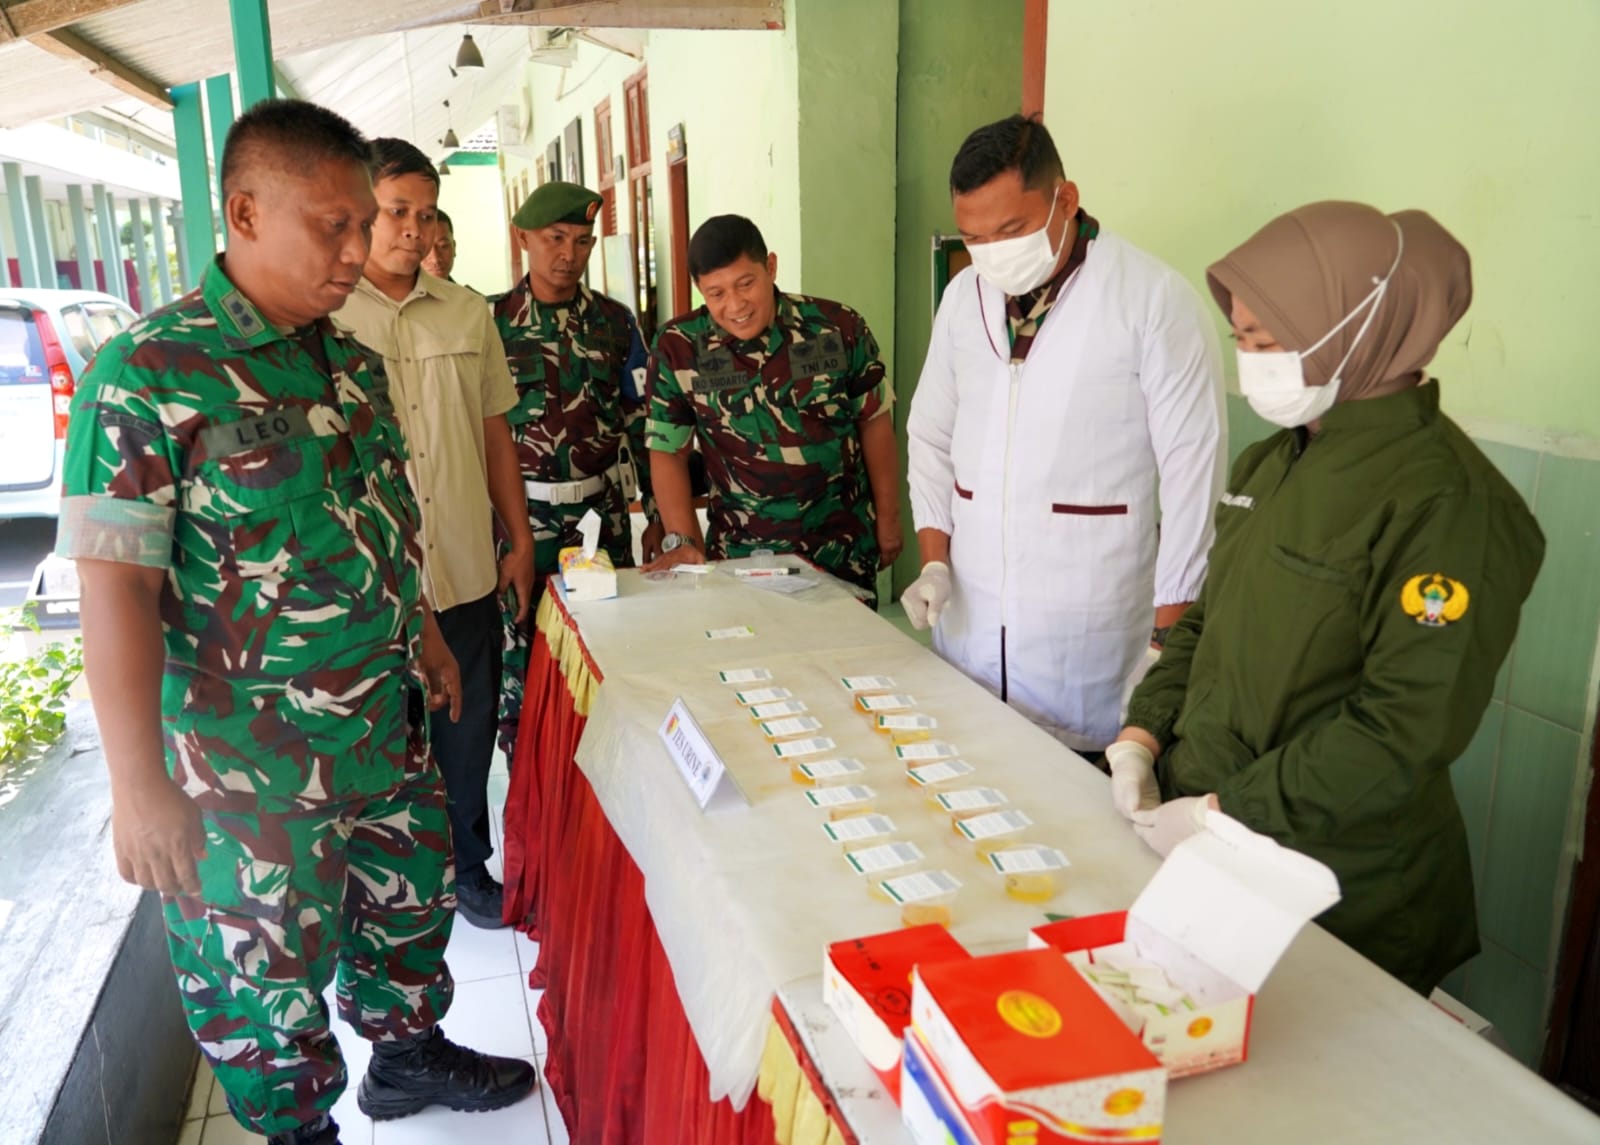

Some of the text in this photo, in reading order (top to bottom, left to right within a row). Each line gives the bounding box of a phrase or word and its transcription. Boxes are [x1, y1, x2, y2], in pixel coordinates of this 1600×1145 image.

[801, 362, 820, 375] TNI
[236, 417, 290, 445] LEO
[681, 741, 702, 778] URINE
